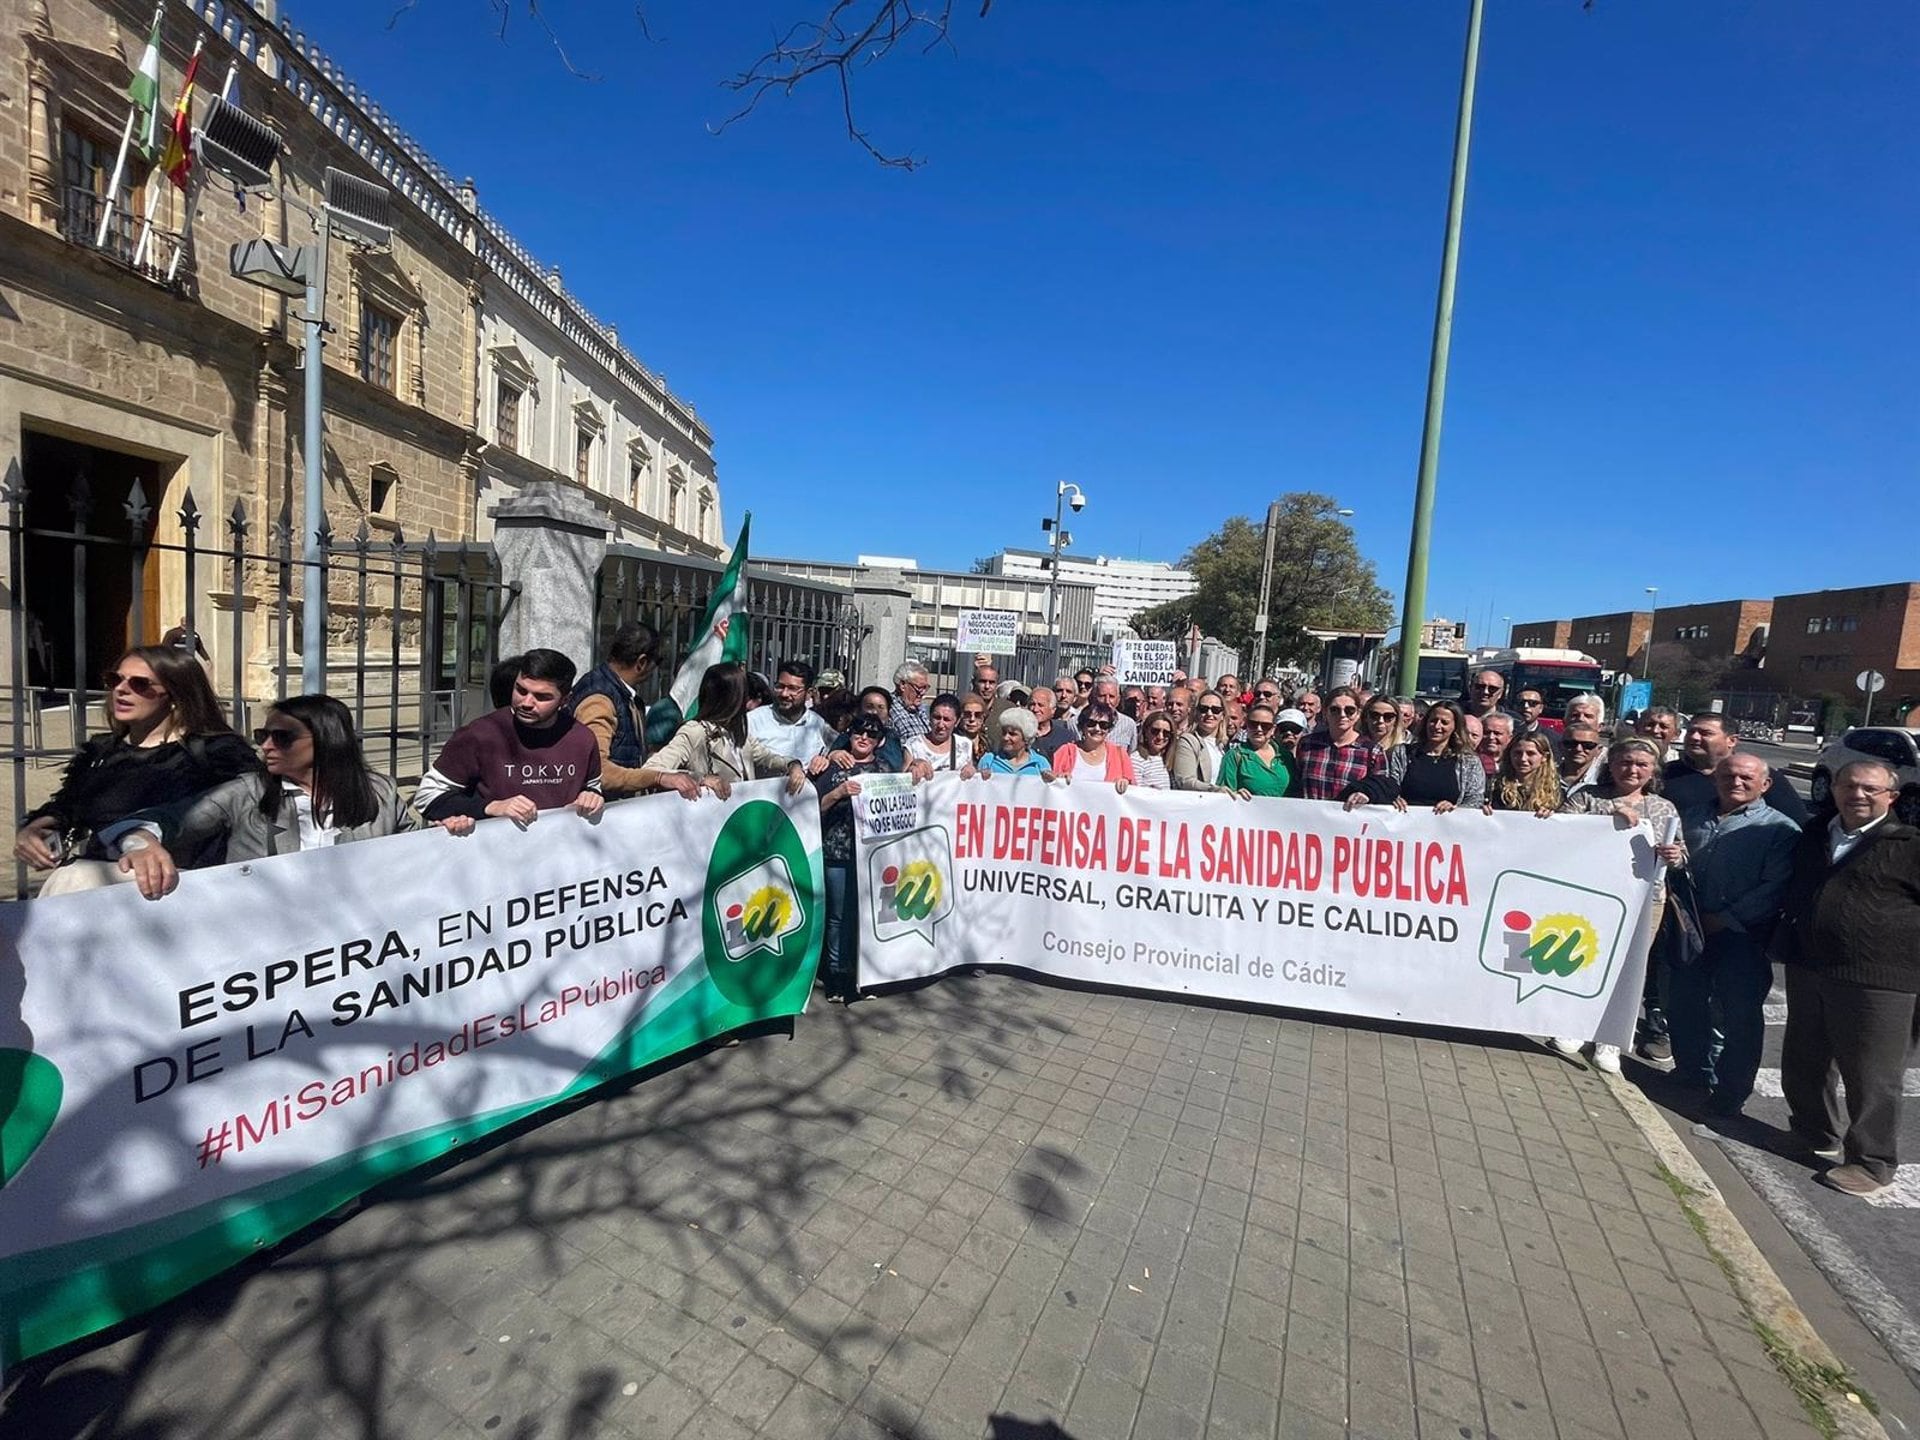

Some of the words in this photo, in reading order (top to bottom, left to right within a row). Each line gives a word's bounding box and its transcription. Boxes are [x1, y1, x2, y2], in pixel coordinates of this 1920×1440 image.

[968, 620, 991, 628] NEGOCIO
[992, 621, 1016, 629] CUANDO
[998, 629, 1015, 637] SALUD
[1133, 643, 1142, 651] TE
[1144, 643, 1174, 652] QUEDAS
[1133, 652, 1142, 660] EN
[1144, 653, 1153, 661] EL
[1133, 661, 1163, 670] PIERDES
[1165, 662, 1175, 670] LA
[1124, 670, 1174, 683] SANIDAD
[504, 764, 576, 777] TOKYO
[870, 797, 888, 815] CON
[889, 796, 898, 812] LA
[898, 793, 917, 811] SALUD
[868, 818, 881, 834] NO
[882, 816, 891, 832] SE
[955, 803, 986, 859] EN
[993, 805, 1107, 871] DEFENSA
[1116, 817, 1151, 876] DE
[1158, 820, 1191, 880] LA
[1200, 824, 1323, 892] SANIDAD
[1333, 824, 1469, 906] PÚBLICA
[964, 869, 1106, 910] UNIVERSAL,
[1116, 884, 1245, 920] GRATUITA
[1252, 899, 1269, 923] Y
[1278, 901, 1315, 928] DE
[1324, 907, 1459, 943] CALIDAD
[178, 930, 420, 1029] ESPERA,
[438, 903, 492, 948] EN
[507, 866, 668, 928] DEFENSA
[1043, 931, 1126, 964] Consejo
[1133, 942, 1240, 975] Provincial
[1247, 955, 1273, 979] de
[1282, 959, 1347, 988] Cádiz
[133, 1036, 224, 1104] DE
[246, 1009, 315, 1062] LA
[331, 939, 532, 1027] SANIDAD
[545, 898, 688, 958] PÚBLICA
[196, 963, 667, 1169] #MiSanidadEsLaPública
